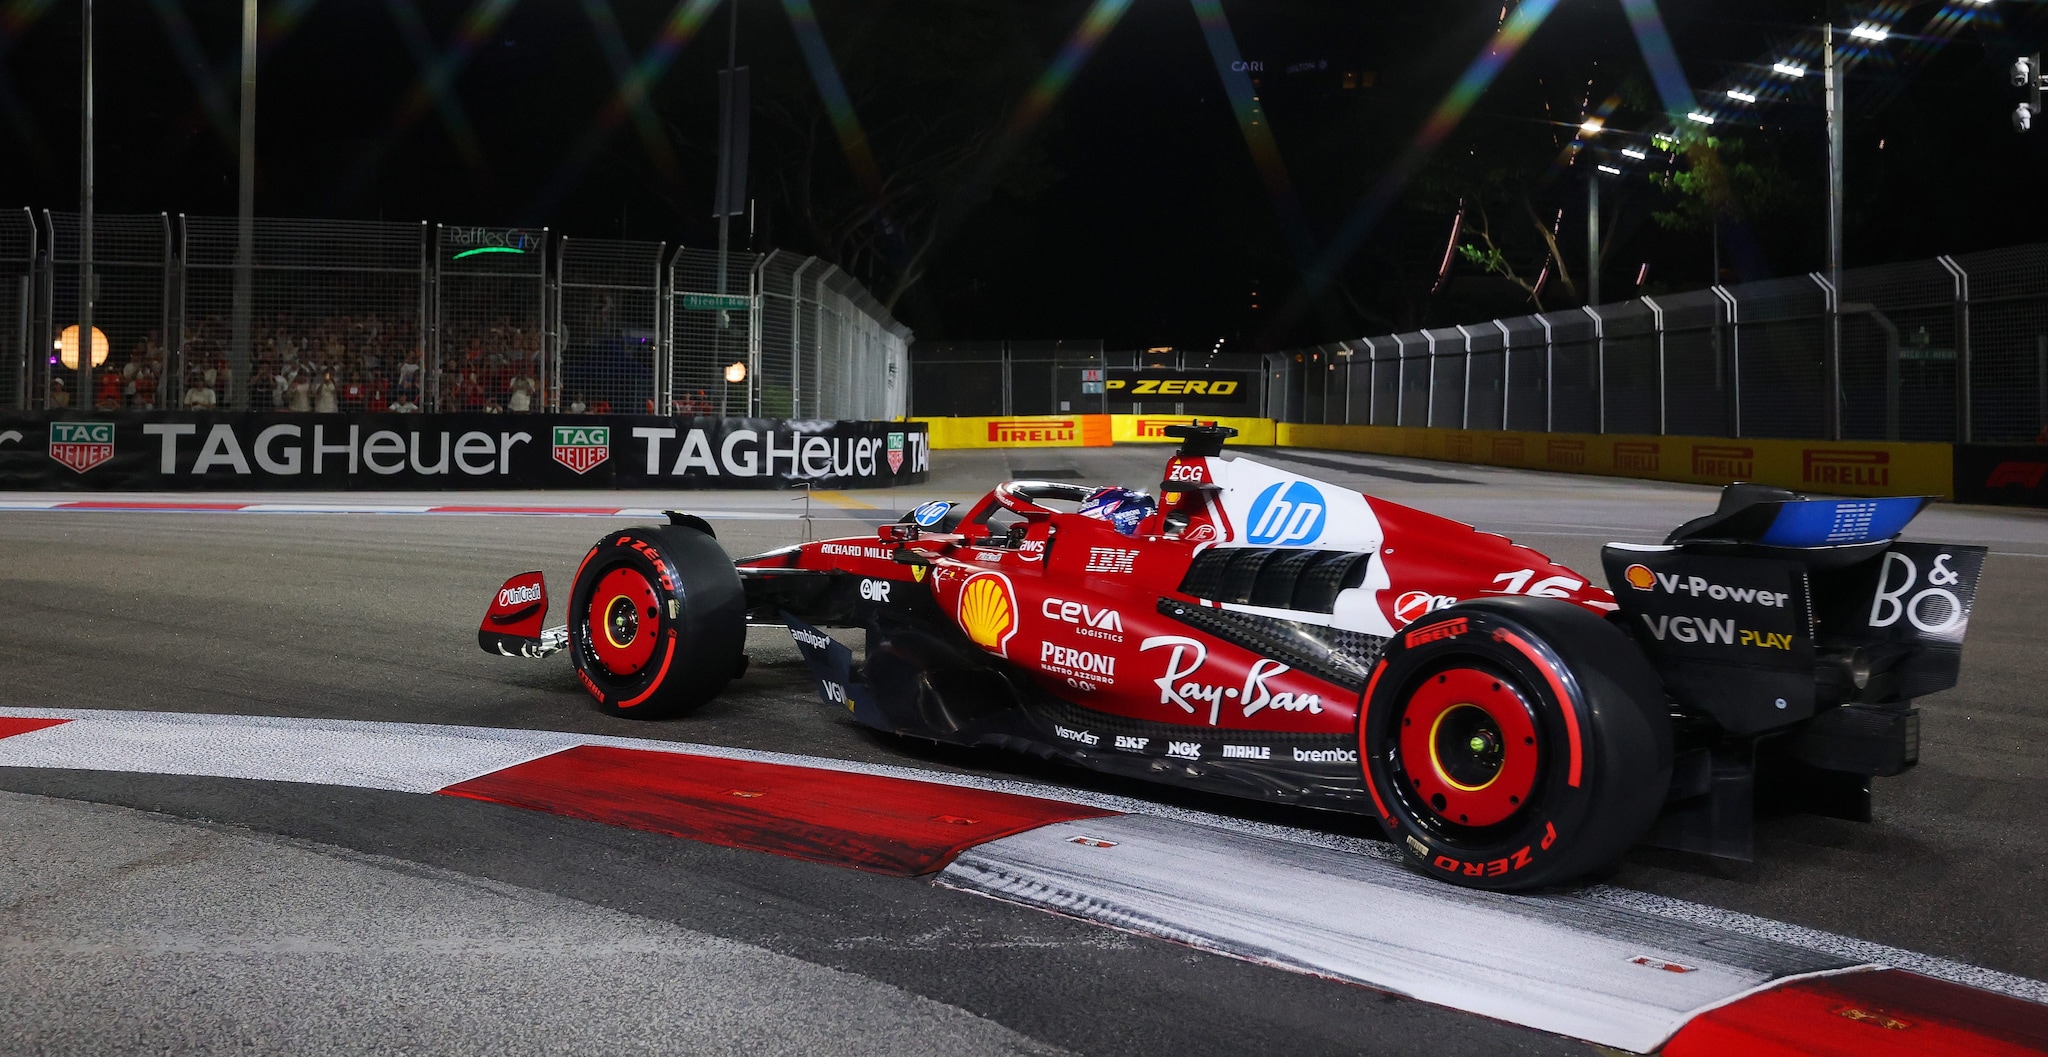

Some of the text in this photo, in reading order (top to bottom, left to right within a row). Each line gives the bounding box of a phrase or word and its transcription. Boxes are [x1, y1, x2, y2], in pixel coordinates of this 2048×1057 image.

[450, 226, 540, 253] Raffles City
[1131, 380, 1239, 395] ZERO
[56, 425, 109, 442] TAG
[558, 429, 605, 445] TAG
[888, 435, 902, 449] TAG
[988, 421, 1074, 441] PIRELLI
[53, 445, 111, 470] HEUER
[556, 448, 606, 471] HEUER
[908, 432, 930, 473] TA
[1614, 442, 1660, 470] PIRELLI
[1692, 446, 1753, 479] PIRELLI
[1803, 450, 1889, 486] PIRELLI
[916, 502, 949, 525] hp
[1249, 481, 1323, 545] hp
[821, 544, 893, 560] RICHARD MILLE
[1020, 540, 1047, 552] aws
[616, 536, 675, 591] P ZERO
[1085, 547, 1140, 574] IBM
[508, 583, 541, 605] UniCredit
[1488, 568, 1584, 599] 16
[1656, 574, 1789, 608] V-Power
[791, 629, 827, 650] ambipar
[1076, 627, 1123, 643] LOGISTICS
[1405, 616, 1469, 649] PIRELLI
[1642, 614, 1793, 651] VGW PLAY
[1041, 640, 1116, 676] PERONI
[1041, 663, 1115, 684] NASTRO AZZURRO
[1114, 736, 1150, 749] SKF
[1167, 741, 1202, 757] NGK
[1222, 745, 1271, 760] MAHLE
[1541, 821, 1558, 850] P
[1433, 846, 1533, 877] ZERO
